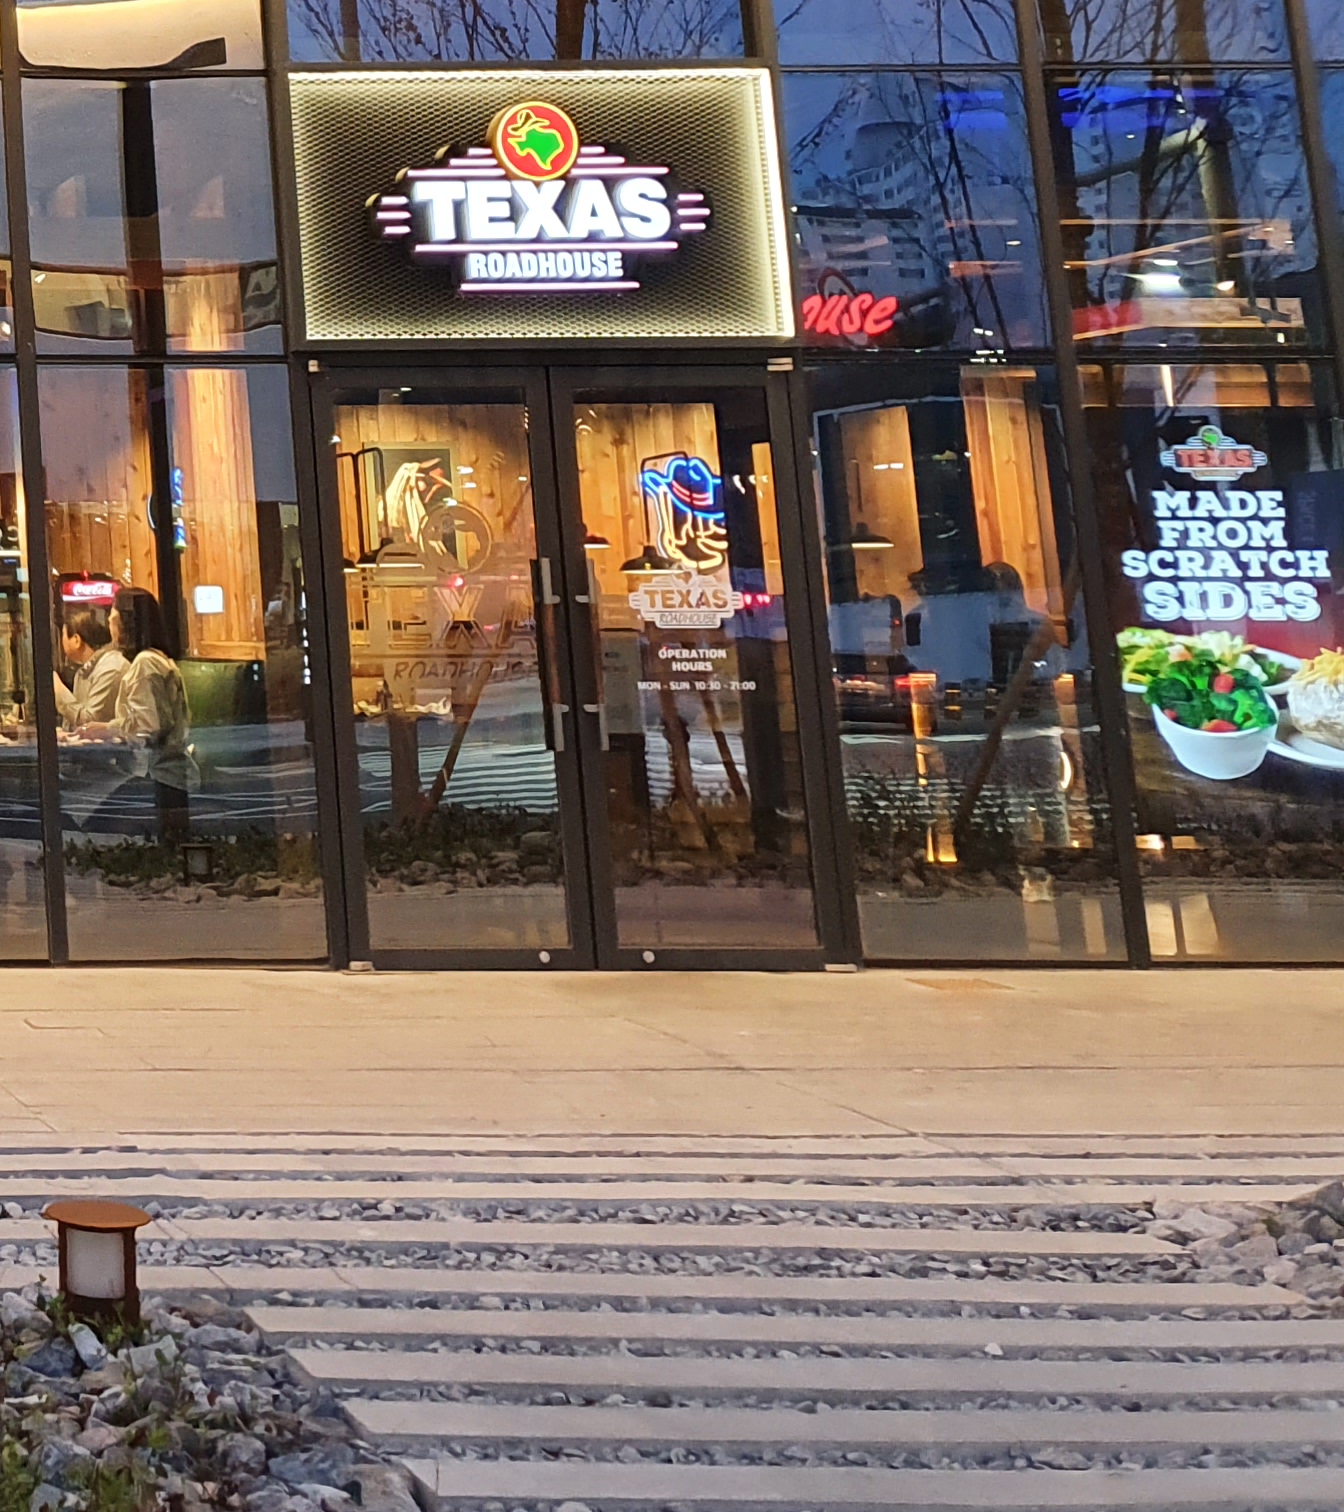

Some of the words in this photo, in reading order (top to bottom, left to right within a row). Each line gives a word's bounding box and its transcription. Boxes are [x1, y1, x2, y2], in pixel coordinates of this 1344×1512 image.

[414, 177, 672, 241] TEXAS
[468, 251, 624, 279] ROADHOUSE
[1176, 449, 1253, 467] TEXAS
[1152, 490, 1286, 517] MADE
[1156, 520, 1287, 548] FROM
[1122, 550, 1331, 578] SCRATCH
[644, 589, 729, 609] TEXAS
[1143, 581, 1321, 621] SIDES
[658, 648, 727, 659] OPERATION
[672, 661, 713, 671] HOURS
[637, 681, 661, 691] MON
[669, 681, 690, 691] SUN
